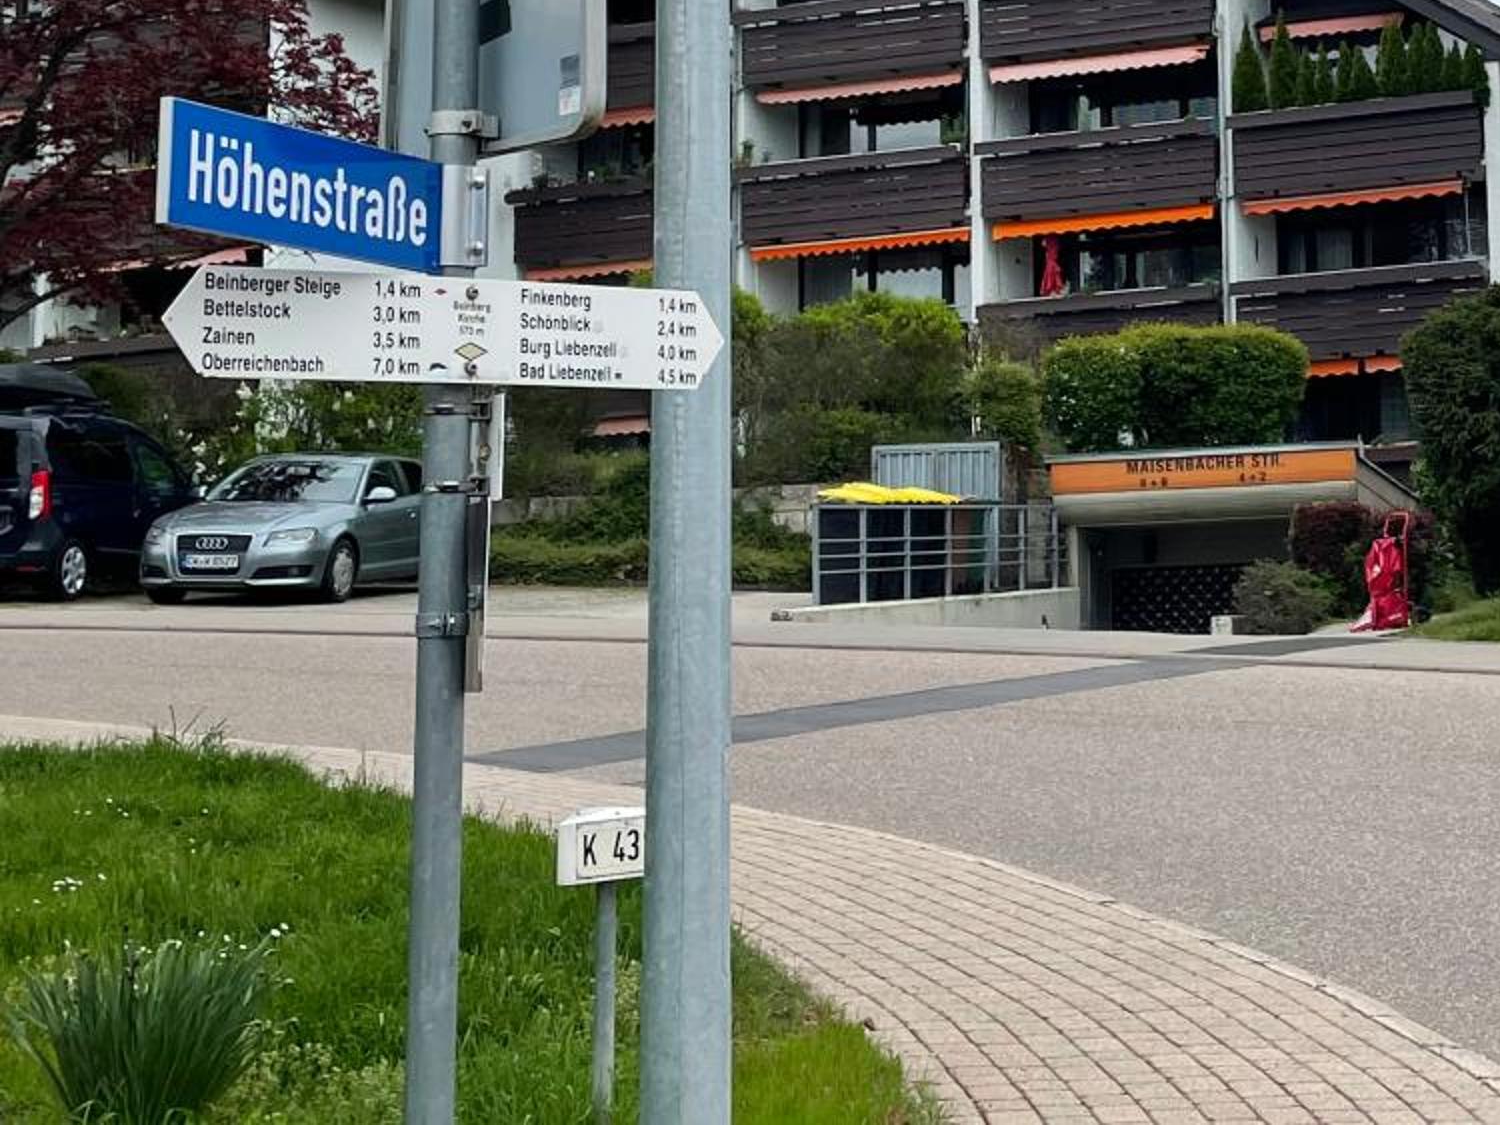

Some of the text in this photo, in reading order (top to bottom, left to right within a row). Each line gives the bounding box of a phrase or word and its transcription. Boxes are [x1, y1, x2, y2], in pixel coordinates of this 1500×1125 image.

[187, 128, 428, 247] Höhenstraße
[204, 272, 421, 299] Beinberger Steige 1,4 km
[203, 298, 421, 325] Bettelstock 3,0 km
[520, 288, 697, 315] Finkenberg 1,4 km
[519, 312, 697, 338] Schönblick 2,4 km
[202, 326, 421, 351] Zainen 3,5 km
[519, 338, 697, 361] Burg Liebenzell 4,0 km
[201, 352, 420, 376] Oberreichenbach 7,0 km
[519, 362, 697, 386] Bad Liebenzell 4,5 km
[1126, 454, 1246, 475] MAISENBACHER
[583, 832, 598, 867] K
